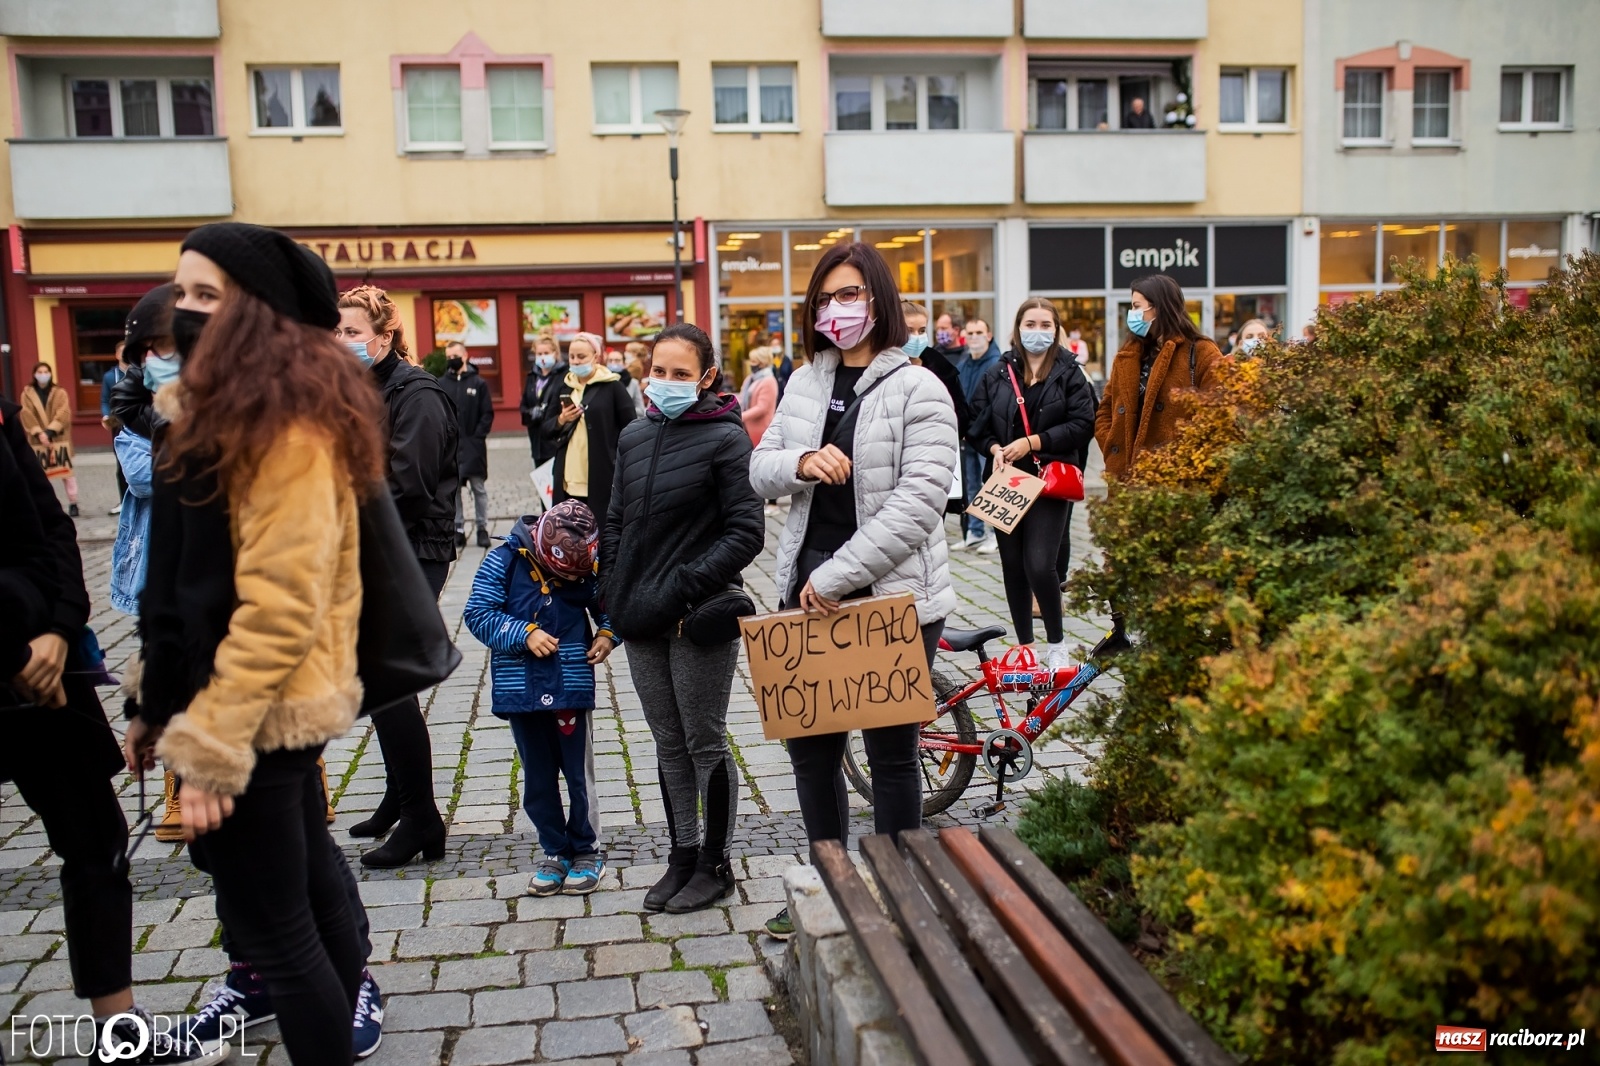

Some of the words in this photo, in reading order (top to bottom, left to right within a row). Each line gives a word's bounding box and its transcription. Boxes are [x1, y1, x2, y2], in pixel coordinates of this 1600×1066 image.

[300, 239, 477, 263] TAURACJA
[1119, 238, 1199, 272] empik
[36, 446, 73, 470] OLNA
[972, 495, 1019, 526] PIEKŁO
[985, 483, 1031, 511] KOBIET
[744, 618, 827, 672] MOJE
[830, 603, 919, 649] CIAŁO
[761, 673, 820, 729] MÓJ
[828, 653, 930, 713] WYBÓR
